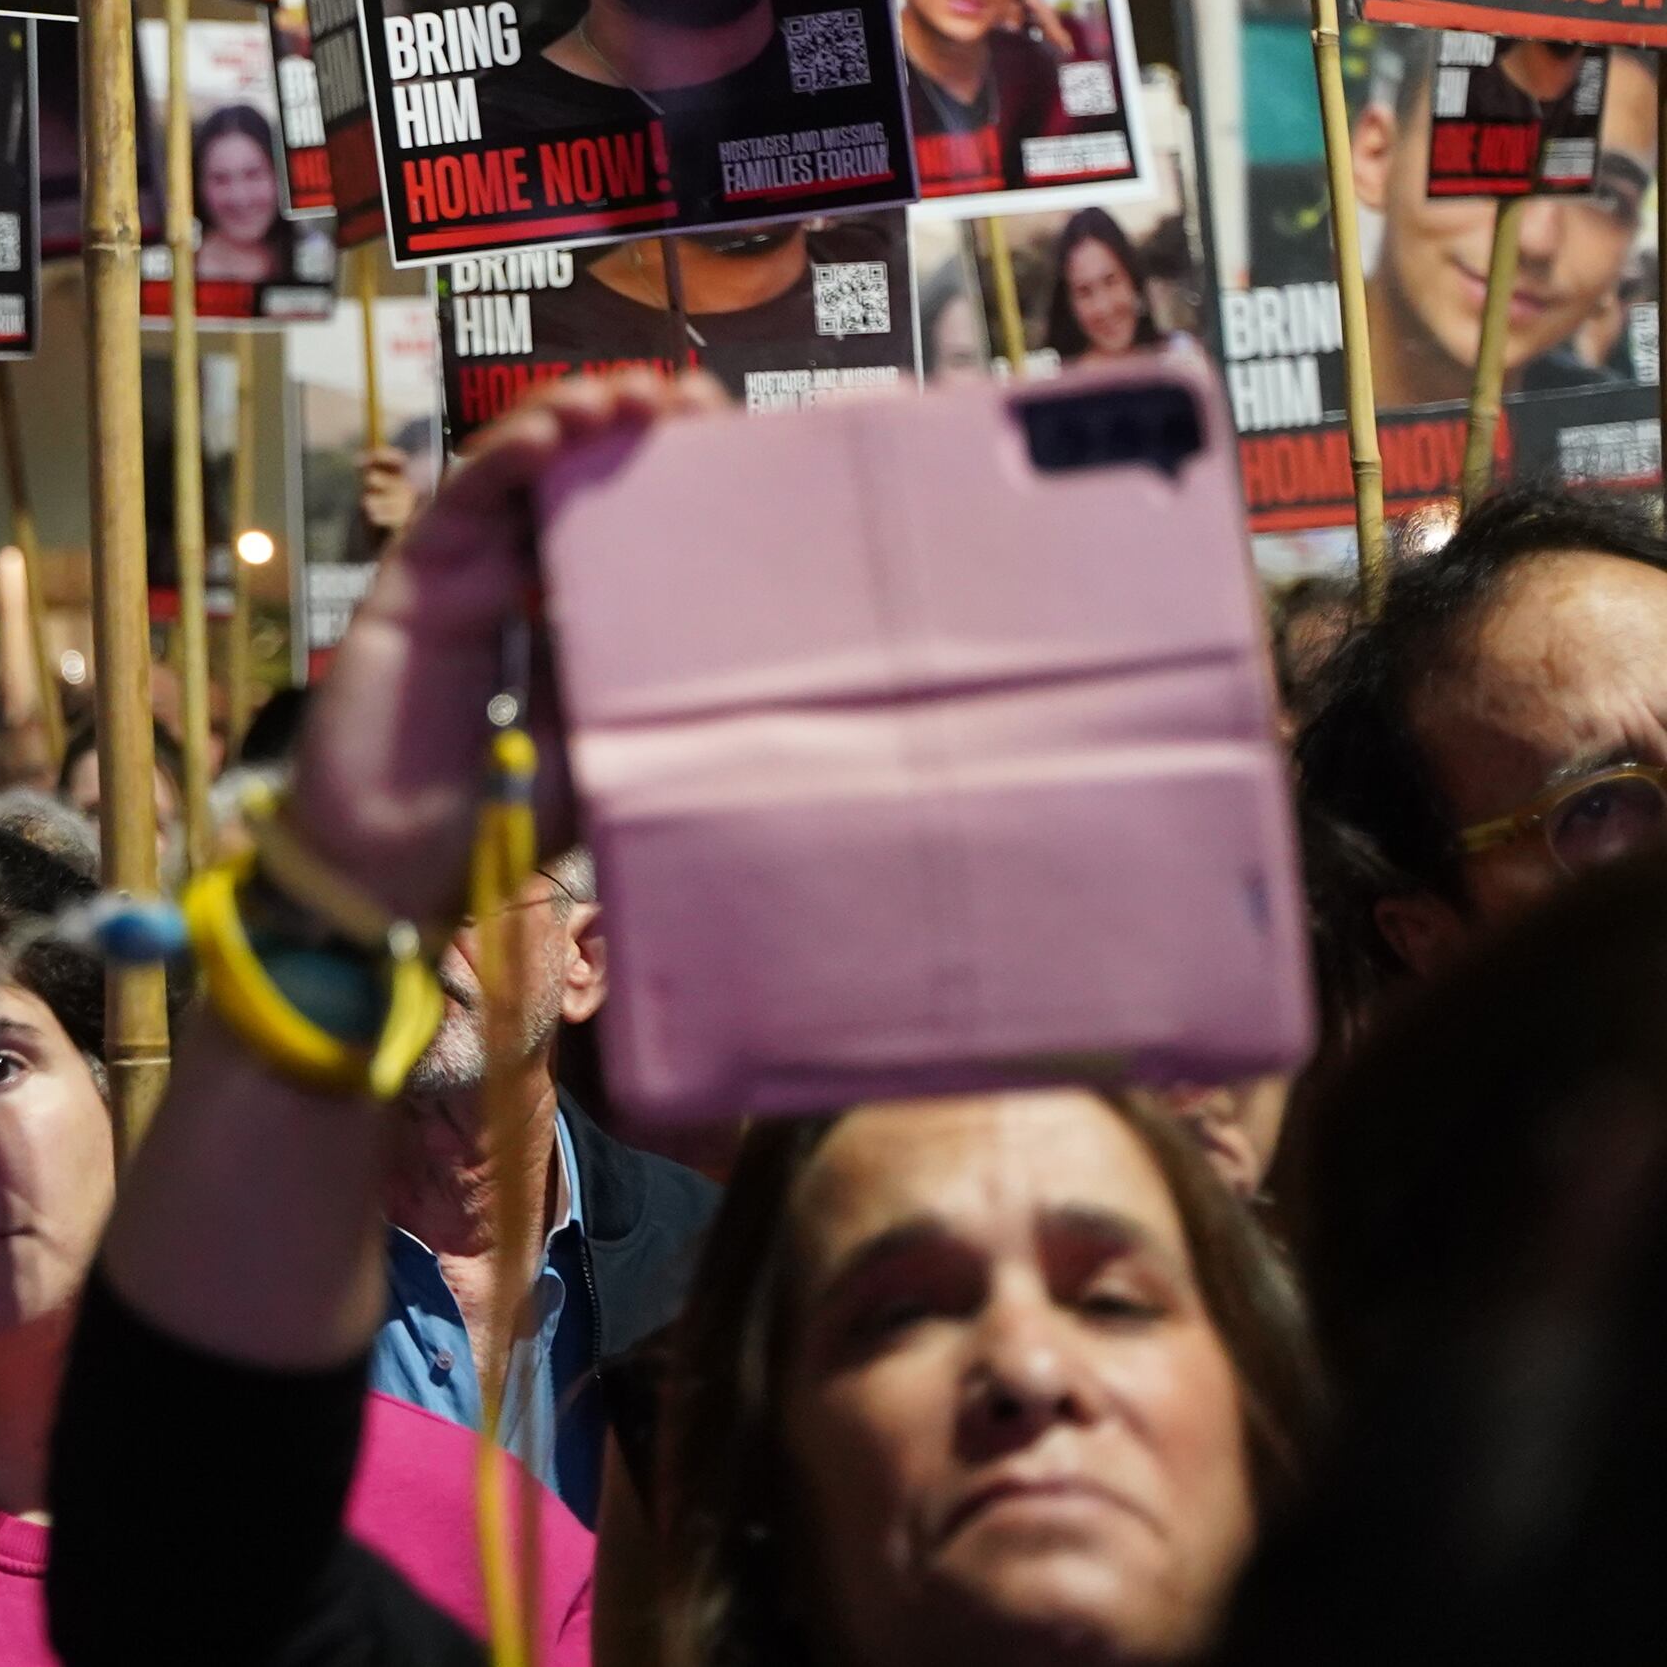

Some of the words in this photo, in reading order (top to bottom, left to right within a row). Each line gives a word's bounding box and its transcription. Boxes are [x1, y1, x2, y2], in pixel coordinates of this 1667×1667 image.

[383, 1, 521, 81] BRING
[391, 77, 482, 149] HIM
[719, 135, 791, 163] HOSTAGES
[792, 130, 821, 156] AND
[823, 122, 887, 151] MISSING
[401, 147, 532, 224] HOME
[537, 119, 673, 208] NOW!
[721, 149, 816, 194] FAMILIES
[817, 138, 890, 181] FORUM
[453, 293, 533, 357] HIM
[1222, 281, 1344, 360] BRIN
[1227, 355, 1323, 434] HIM
